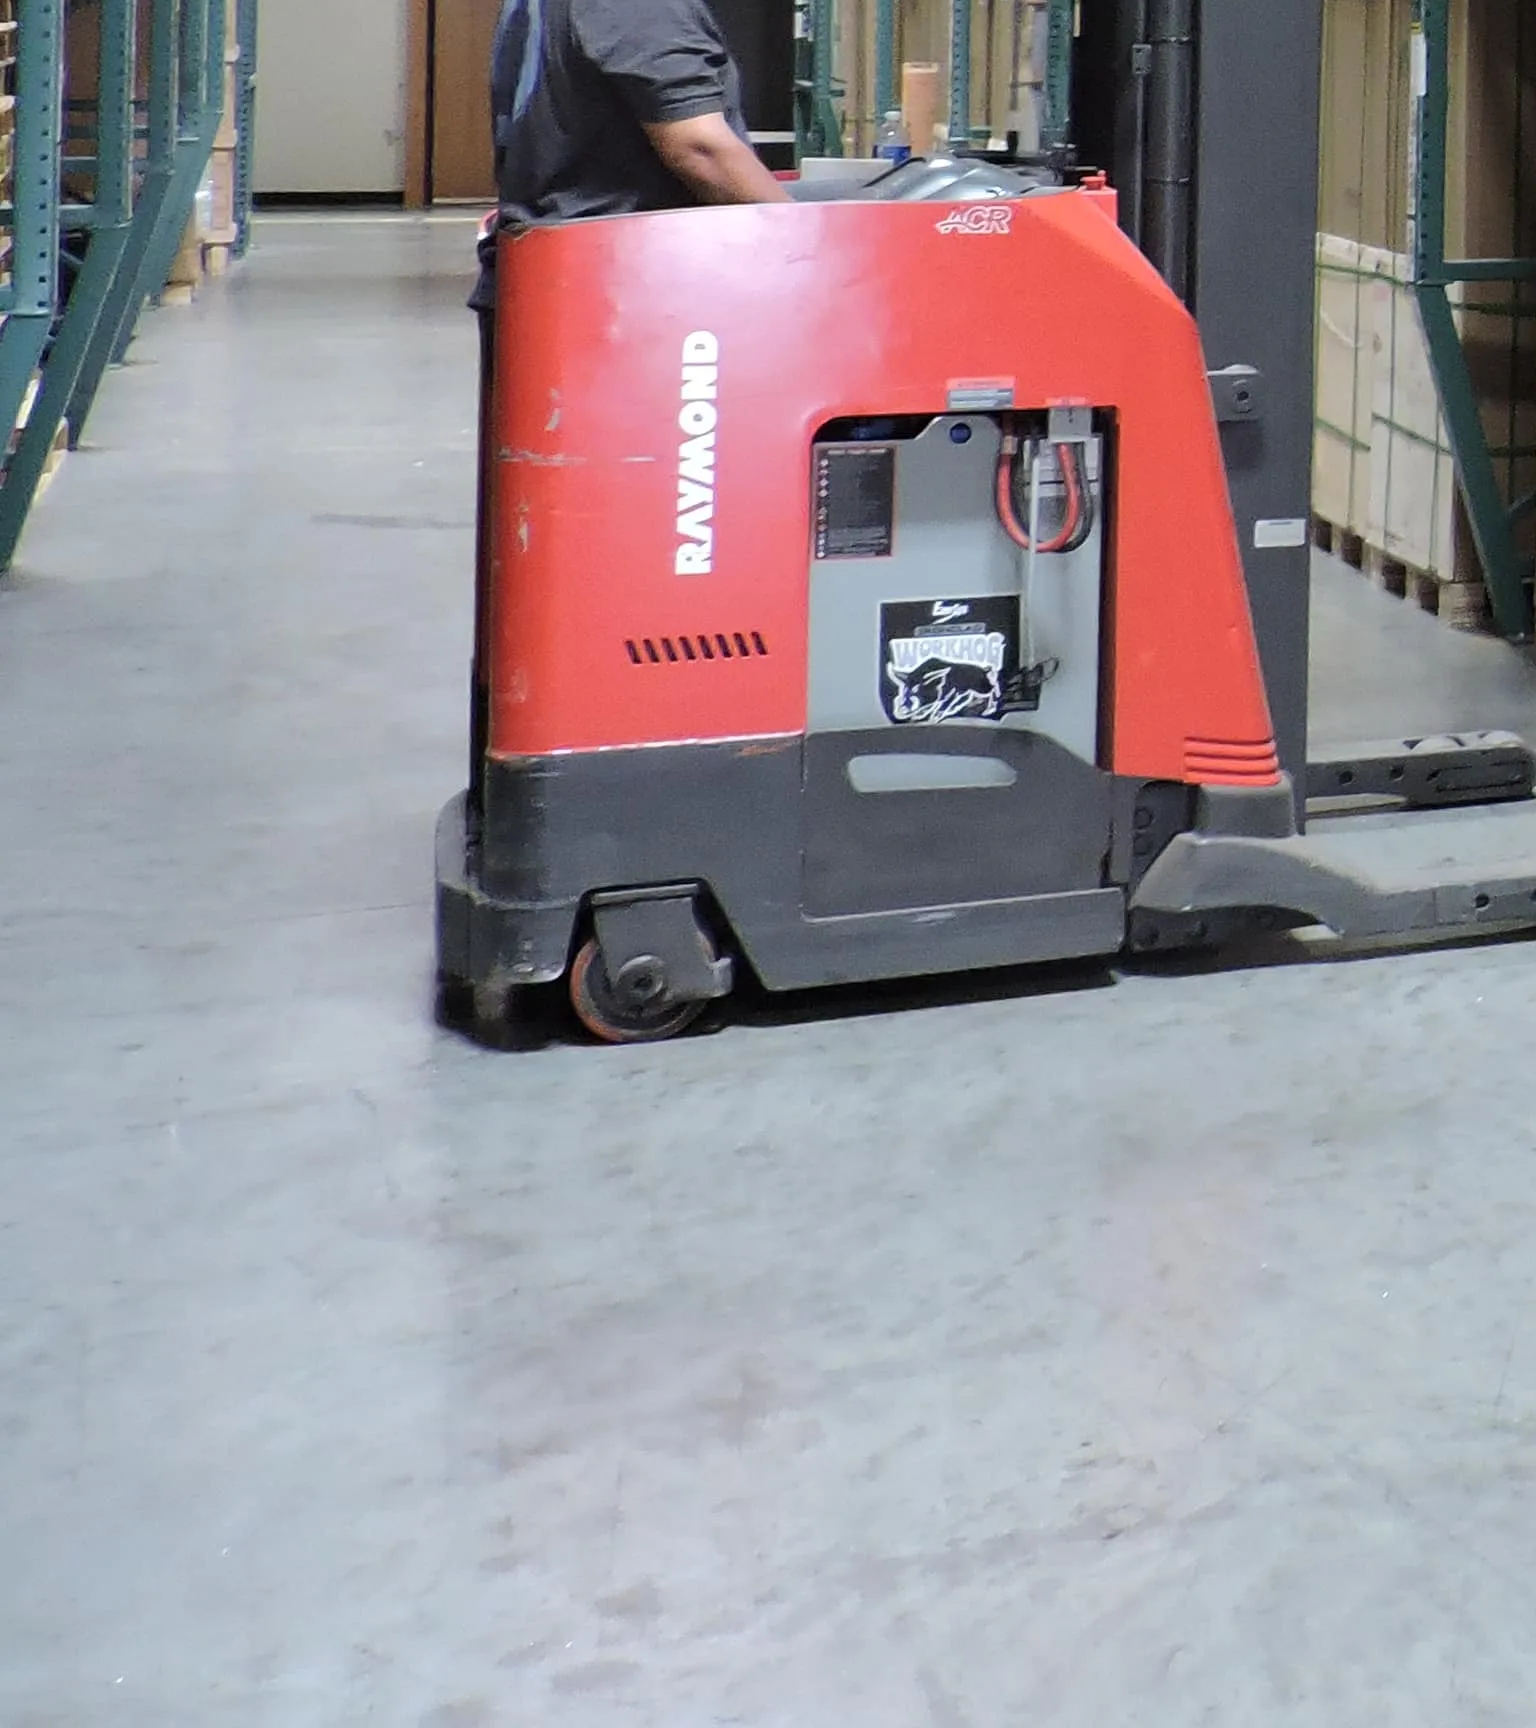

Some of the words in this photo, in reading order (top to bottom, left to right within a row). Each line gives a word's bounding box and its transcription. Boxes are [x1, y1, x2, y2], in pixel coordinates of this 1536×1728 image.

[936, 205, 1012, 235] ACR
[675, 330, 719, 575] RAYMOND
[891, 633, 1003, 672] WORKHOG
